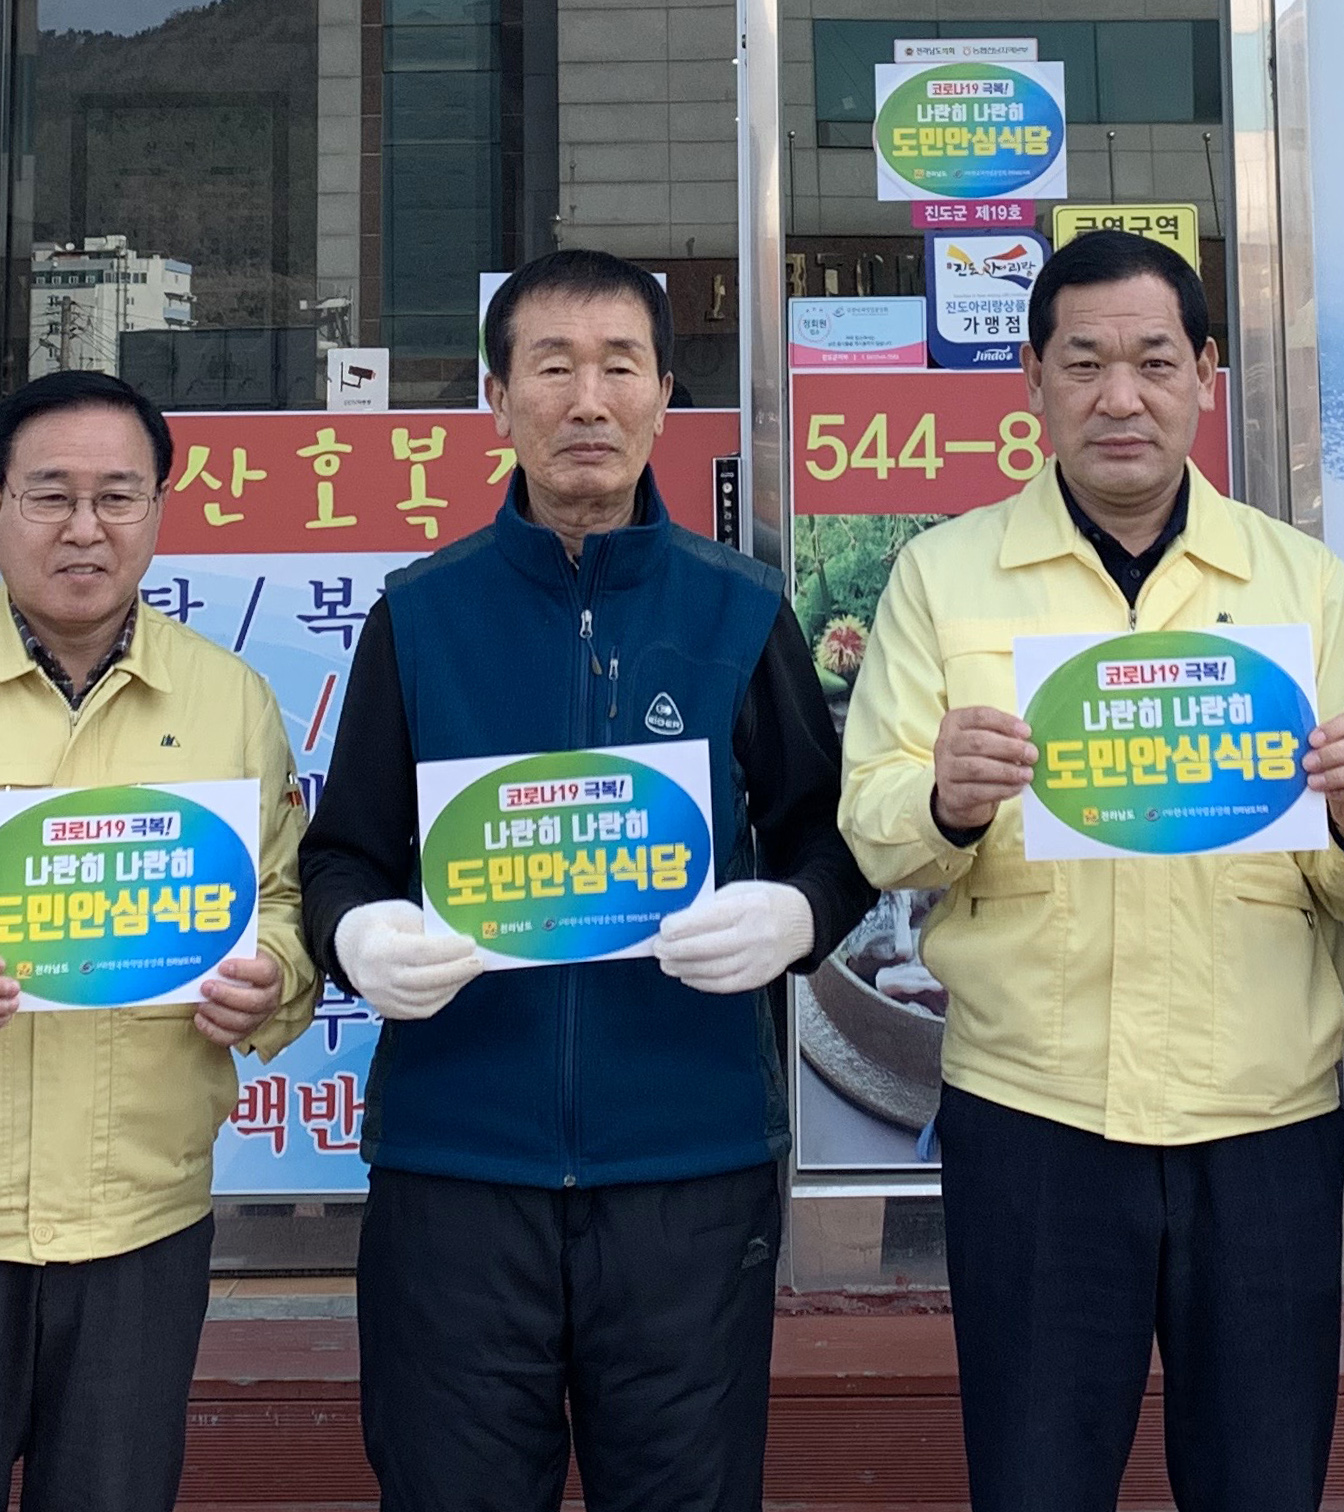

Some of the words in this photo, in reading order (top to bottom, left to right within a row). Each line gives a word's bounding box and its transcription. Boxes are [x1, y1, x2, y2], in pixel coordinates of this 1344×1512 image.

[932, 83, 979, 96] 코로나19
[917, 103, 967, 123] 나란히
[973, 102, 1024, 122] 나란히
[892, 125, 1052, 157] 도민안심식당
[925, 205, 968, 222] 진도군
[975, 204, 1023, 221] 제19호
[946, 300, 1028, 315] 진도아리랑상품
[964, 315, 1021, 335] 가맹점
[973, 346, 1008, 362] Jindo
[805, 411, 1047, 481] 544-8
[175, 425, 518, 539] 산호복
[1105, 664, 1180, 686] 코로나19
[1185, 661, 1228, 682] 극복!
[1083, 697, 1164, 731] 나란히
[1173, 693, 1254, 727] 나란히
[1046, 731, 1299, 789] 도민안심식당
[506, 783, 579, 807] 코로나19
[584, 779, 625, 799] 극복!
[50, 819, 126, 842] 코로나19
[130, 816, 173, 837] 극복!
[484, 816, 561, 851] 나란히
[572, 808, 649, 843] 나란히
[25, 851, 105, 886] 나란히
[116, 846, 195, 882] 나란히
[447, 842, 692, 906] 도민안심식당
[229, 1074, 365, 1155] 백반
